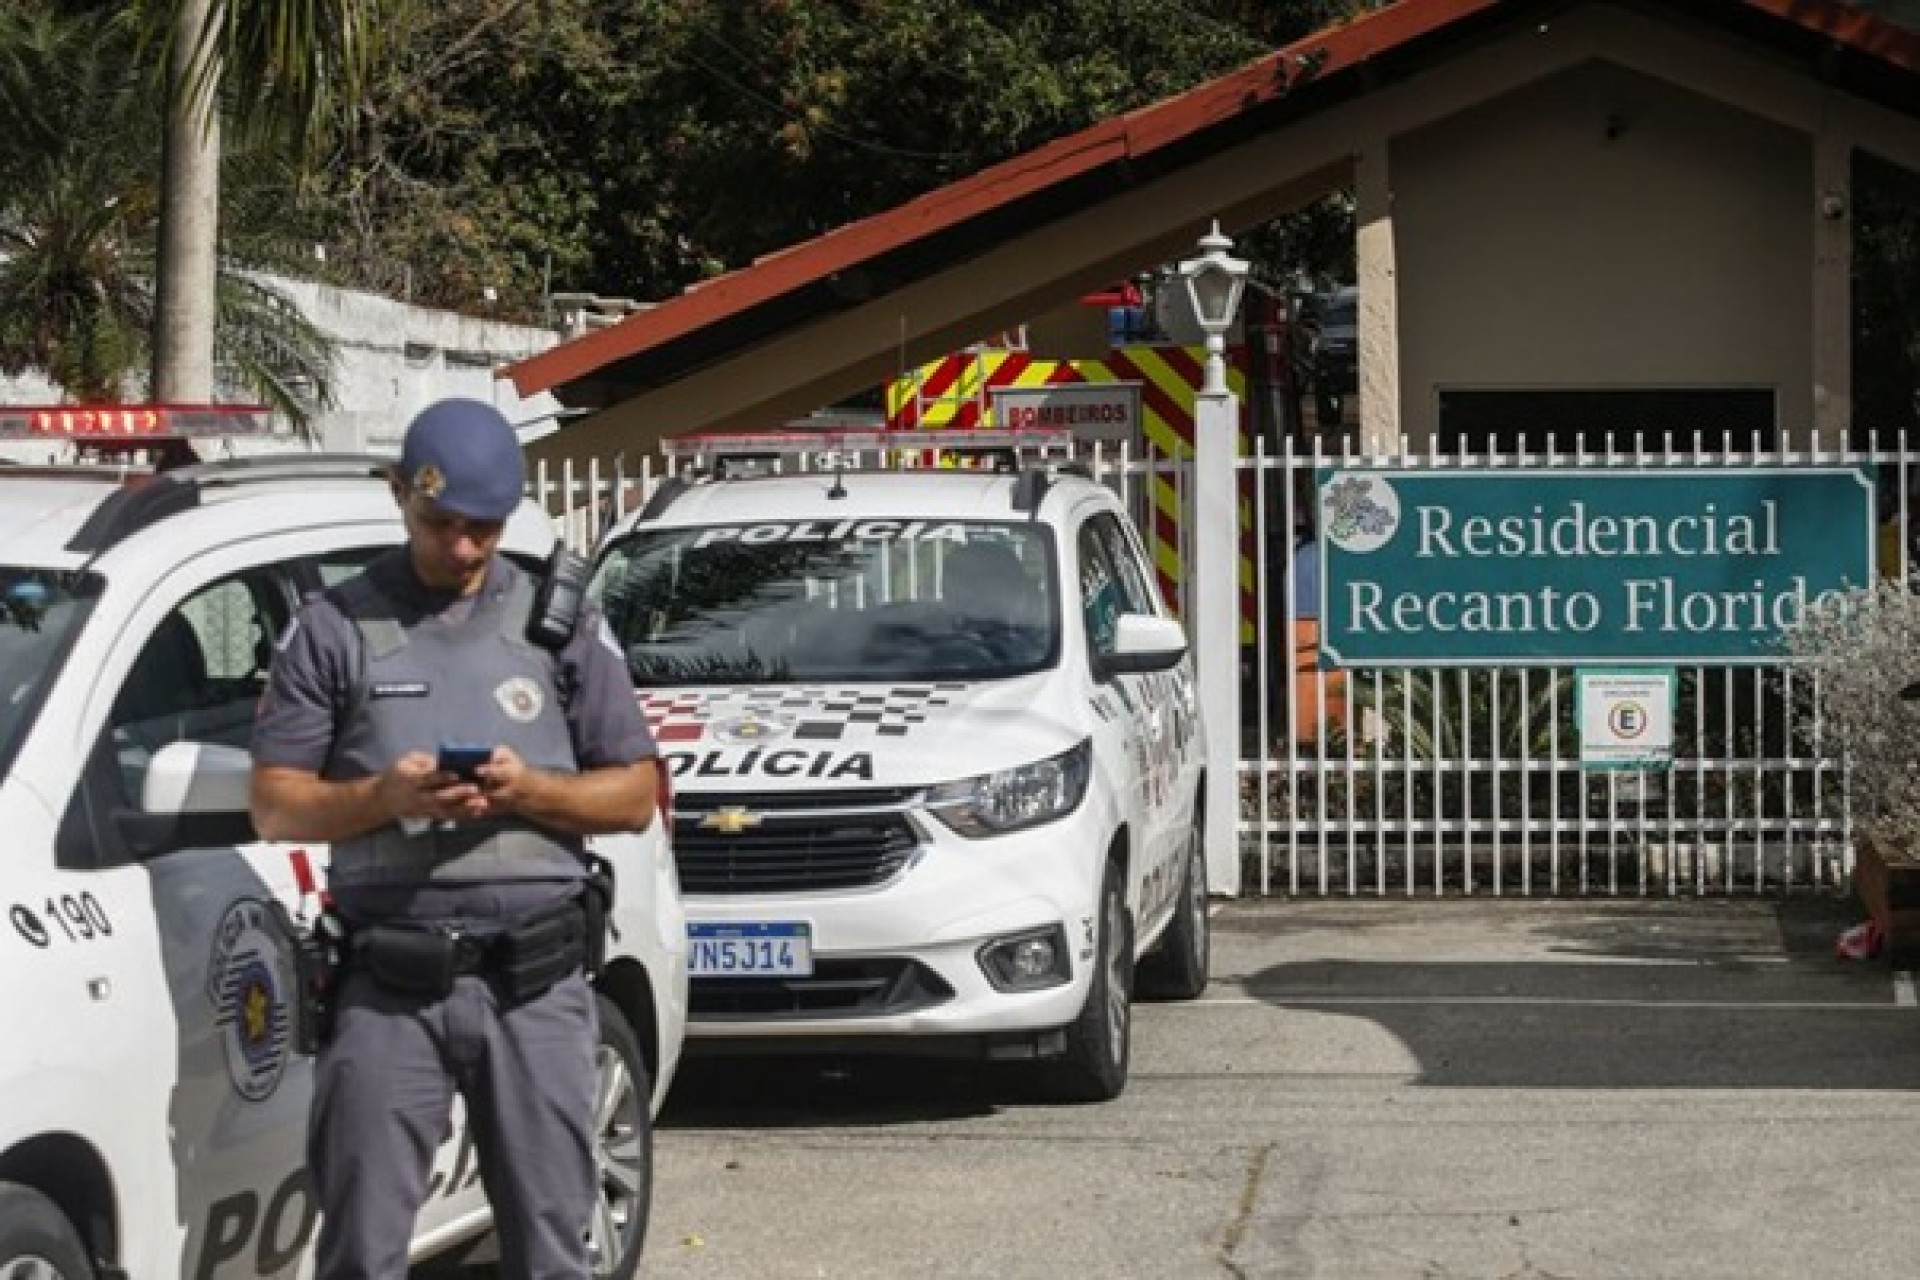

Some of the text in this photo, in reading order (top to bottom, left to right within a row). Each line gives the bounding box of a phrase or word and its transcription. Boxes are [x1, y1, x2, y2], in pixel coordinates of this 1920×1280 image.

[1009, 404, 1127, 430] BOMBEIROS
[1415, 501, 1781, 557] Residencial
[1346, 580, 1601, 633] Recanto
[665, 744, 873, 780] OLÍCIA
[45, 890, 112, 942] 190
